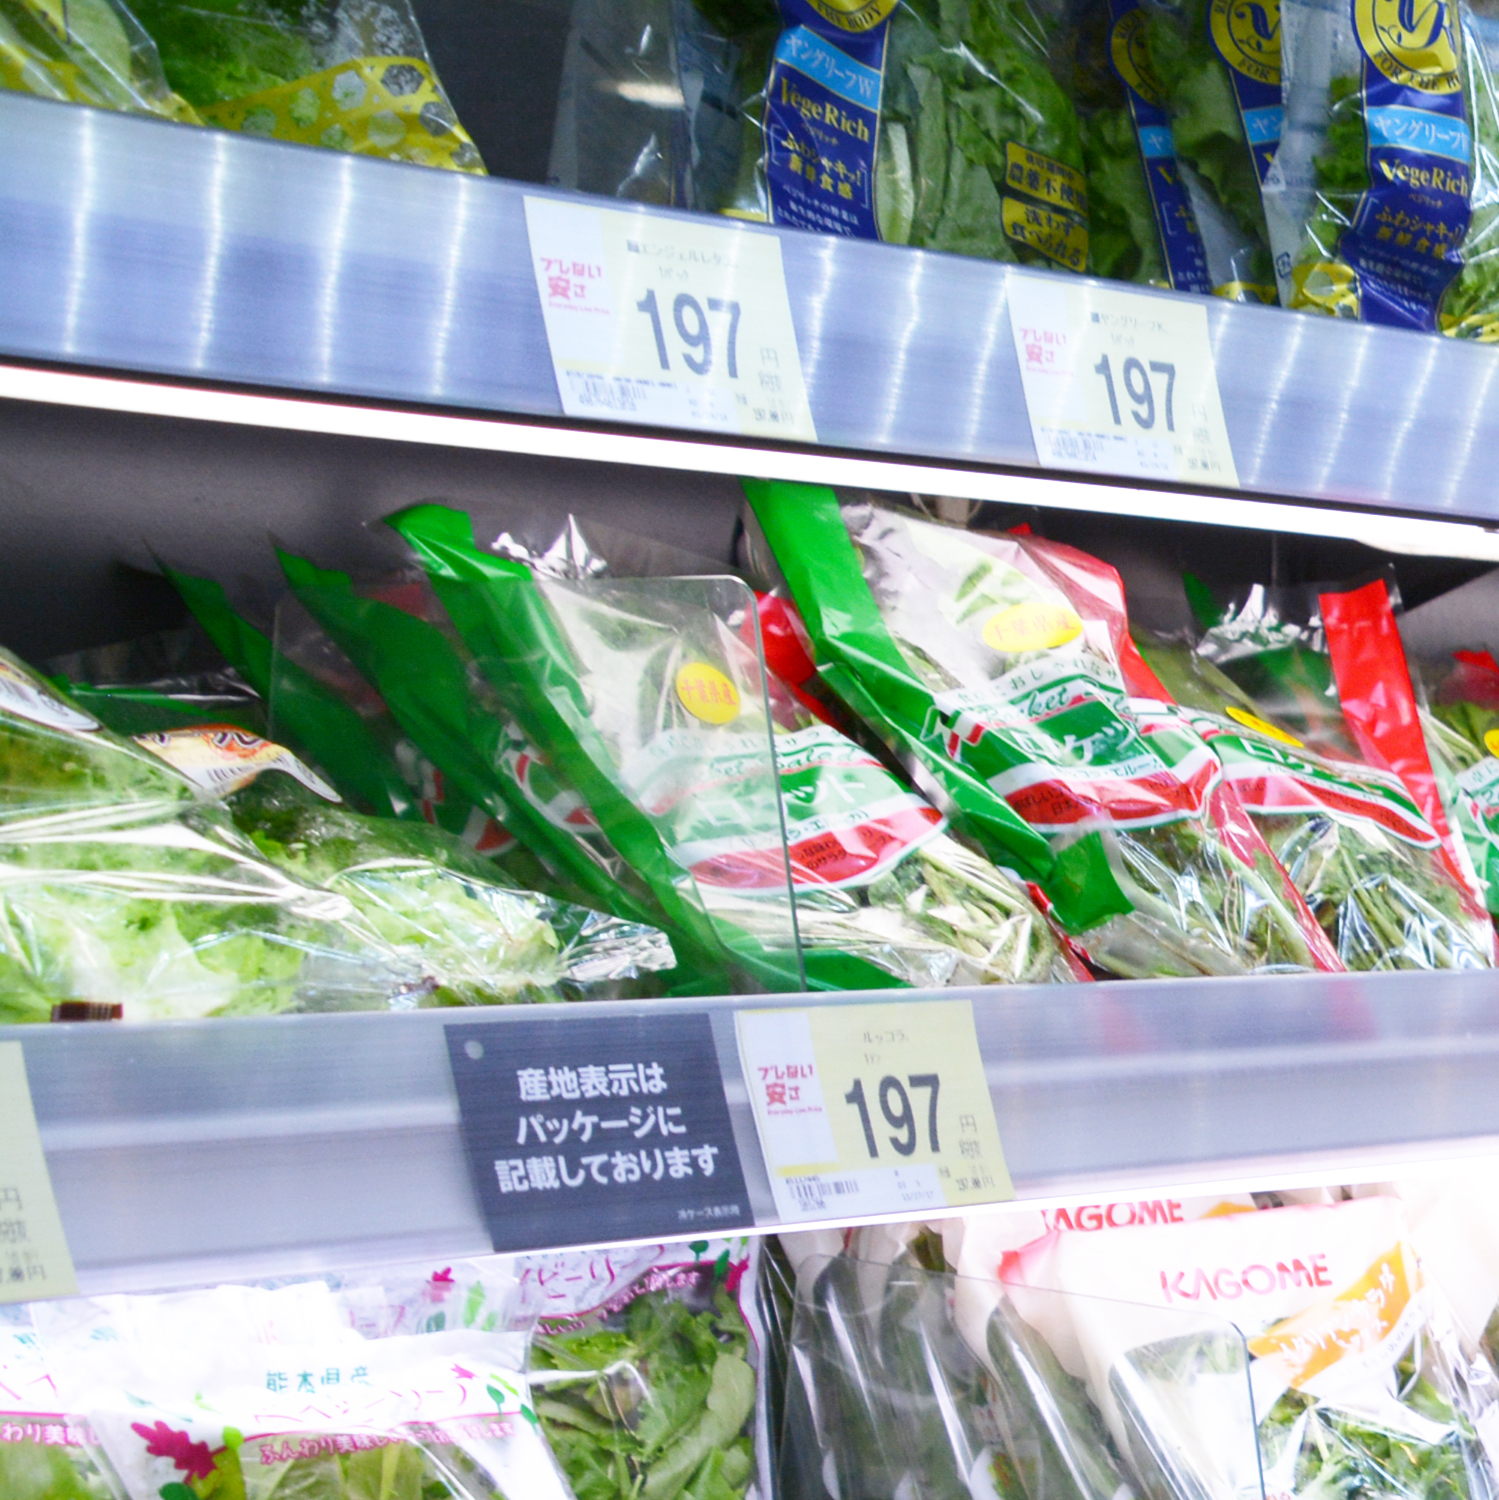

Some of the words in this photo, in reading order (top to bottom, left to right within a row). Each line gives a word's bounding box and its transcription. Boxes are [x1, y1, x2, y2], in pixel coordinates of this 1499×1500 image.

[1374, 49, 1402, 83] FOR
[781, 77, 870, 143] VegeRich
[1378, 158, 1470, 198] VegeRich
[547, 276, 587, 301] 安さ
[635, 287, 741, 380] 197
[1093, 353, 1177, 433] 197
[516, 1061, 668, 1103] 産地表示は
[765, 1081, 801, 1107] 安さ
[516, 1104, 688, 1145] パッケージに
[844, 1072, 941, 1160] 197
[959, 1113, 977, 1134] 円
[494, 1143, 719, 1194] 記載しております
[1159, 1253, 1333, 1304] KAGOME
